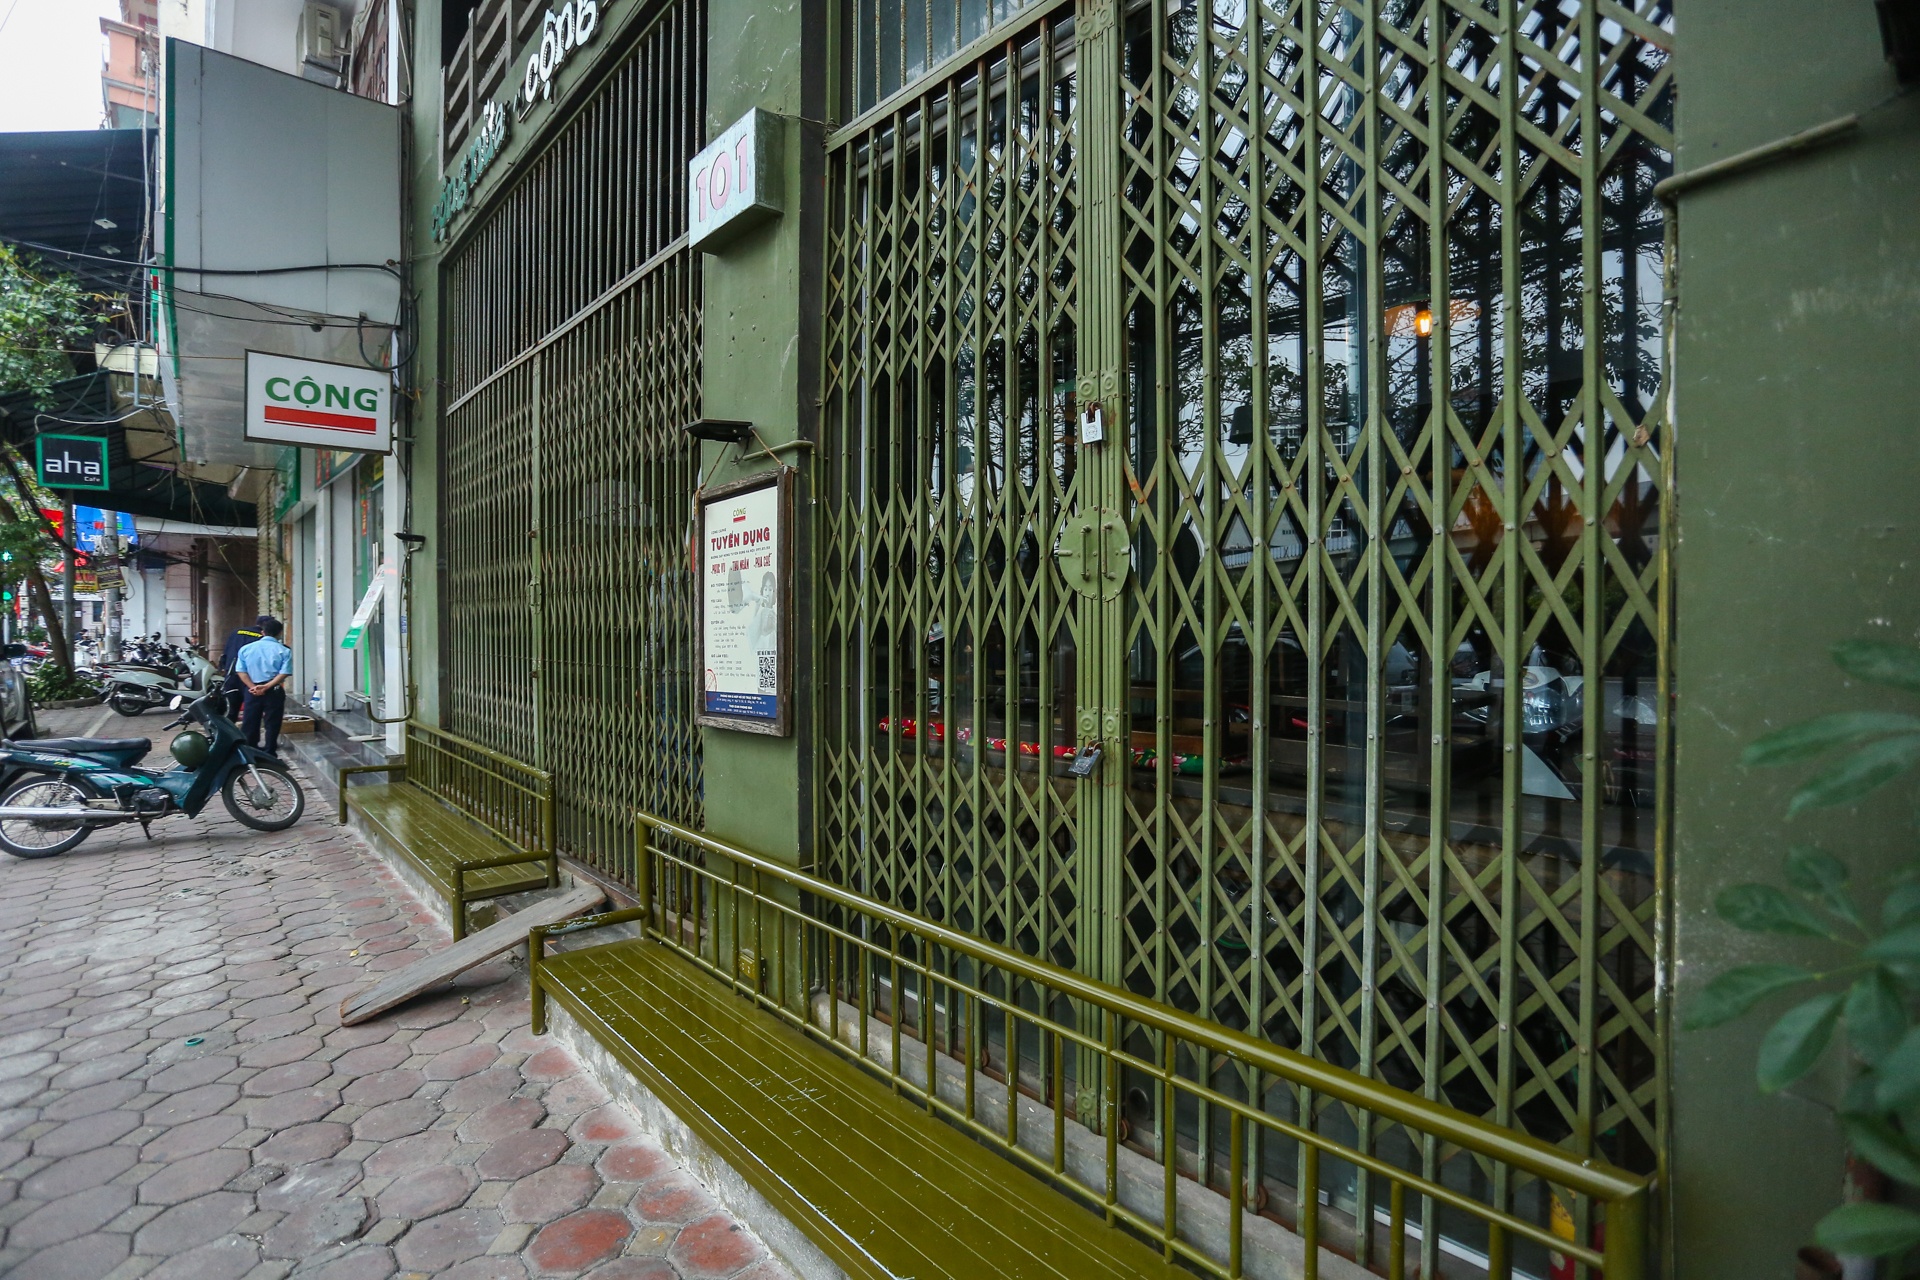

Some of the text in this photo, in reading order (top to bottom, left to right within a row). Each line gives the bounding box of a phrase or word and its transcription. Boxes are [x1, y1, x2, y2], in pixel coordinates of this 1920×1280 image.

[695, 133, 748, 223] 101
[265, 375, 378, 412] CỘNG
[45, 451, 100, 475] aha
[743, 527, 770, 546] DỤNG
